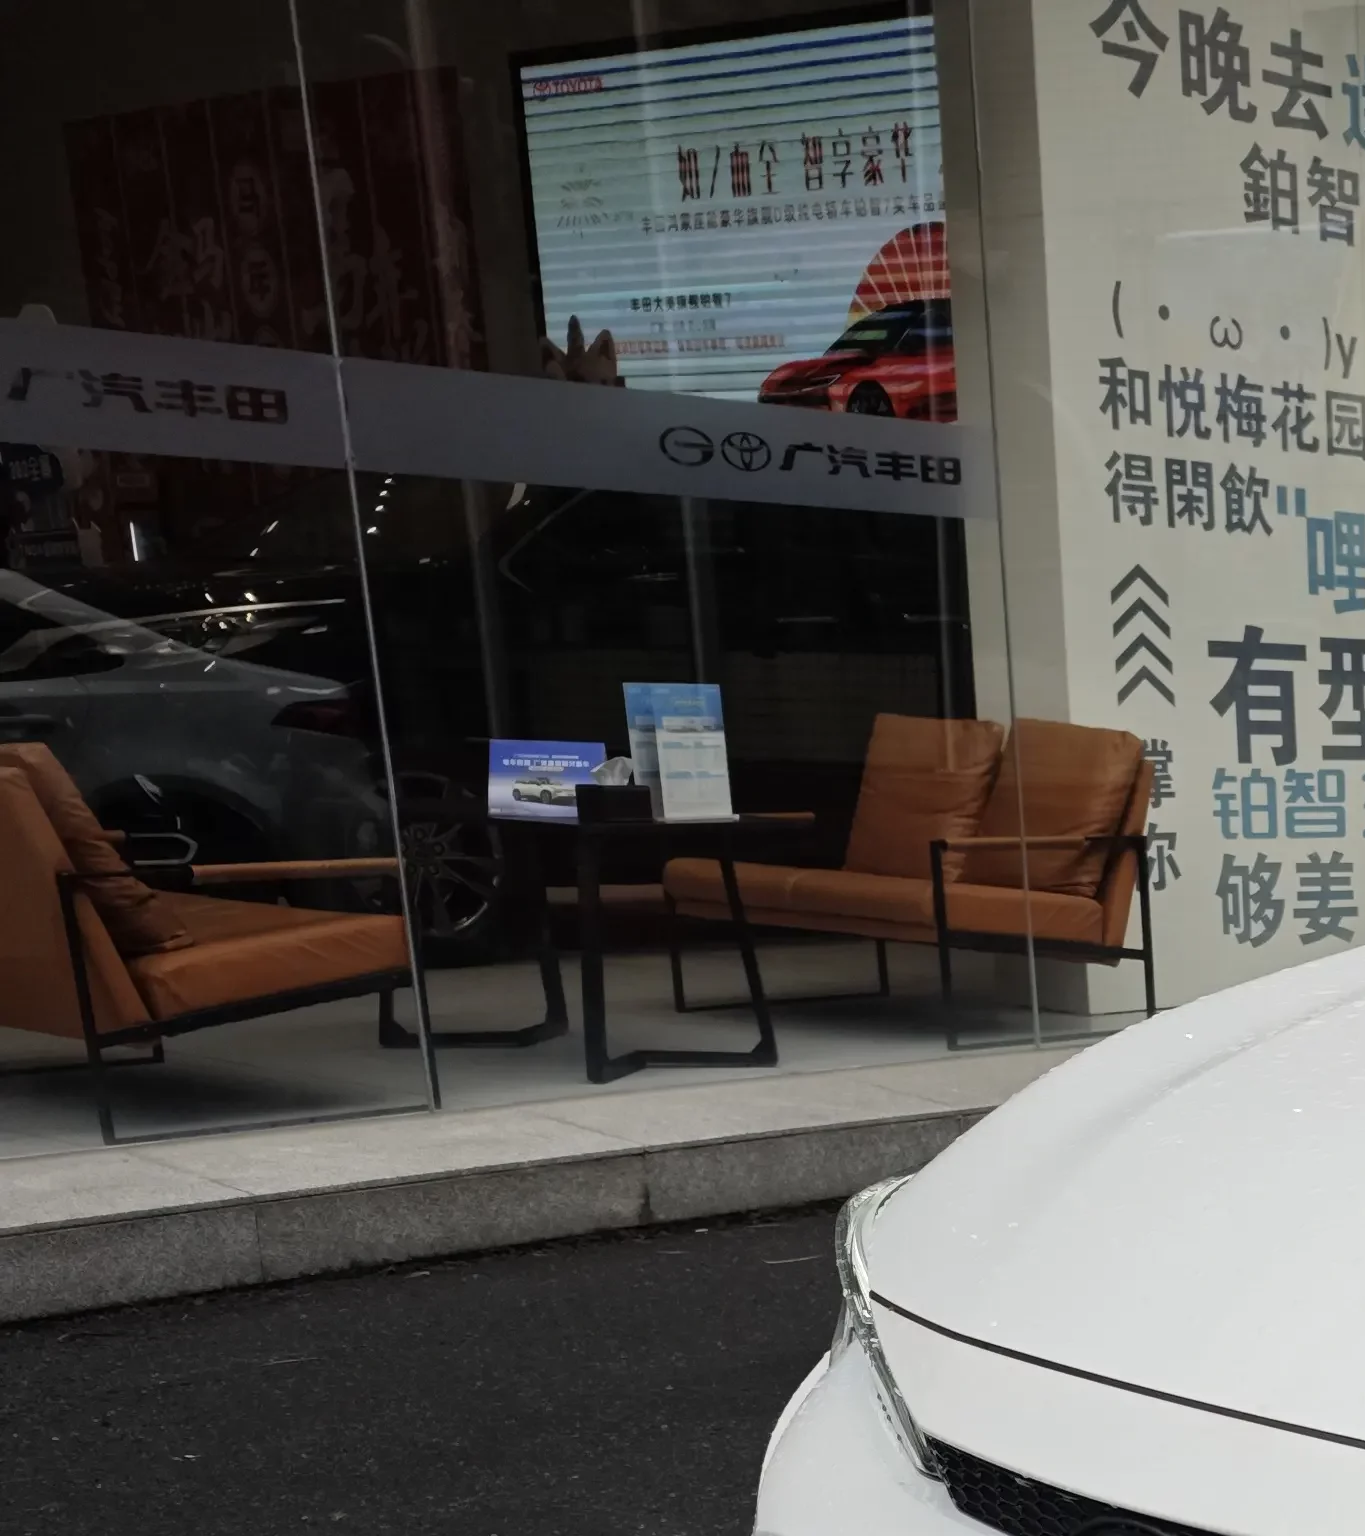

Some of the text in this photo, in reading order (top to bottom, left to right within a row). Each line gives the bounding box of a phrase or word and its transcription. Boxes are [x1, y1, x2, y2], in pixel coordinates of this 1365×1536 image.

[7, 367, 289, 424] 广汽丰田
[779, 442, 962, 485] 广汽丰田
[1215, 850, 1360, 947] 够姜
